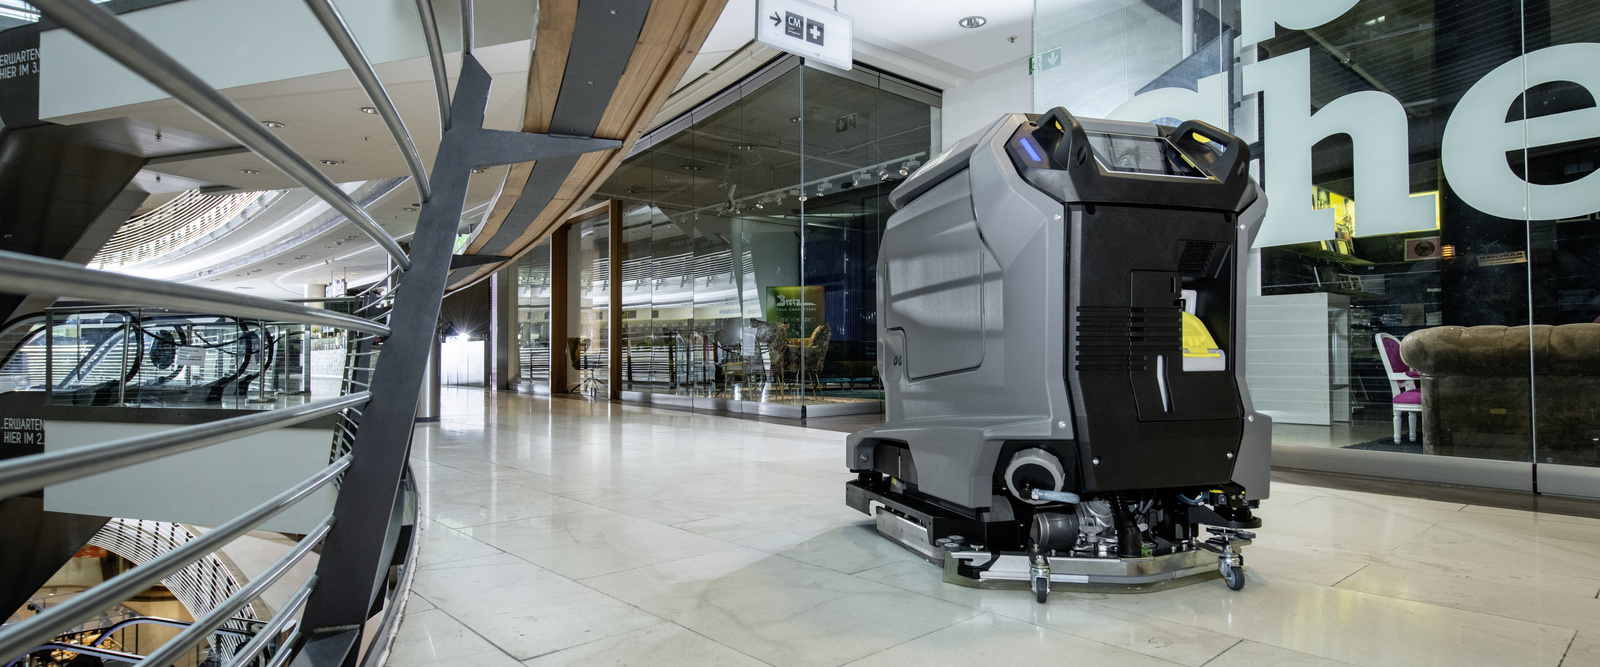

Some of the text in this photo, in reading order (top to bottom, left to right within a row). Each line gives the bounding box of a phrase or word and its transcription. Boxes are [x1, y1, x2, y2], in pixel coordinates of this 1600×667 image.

[788, 16, 801, 28] CM
[0, 47, 40, 67] ERWARTEN
[0, 65, 17, 80] HIER
[19, 63, 30, 77] IM
[4, 431, 22, 444] HIER
[23, 432, 34, 445] IM
